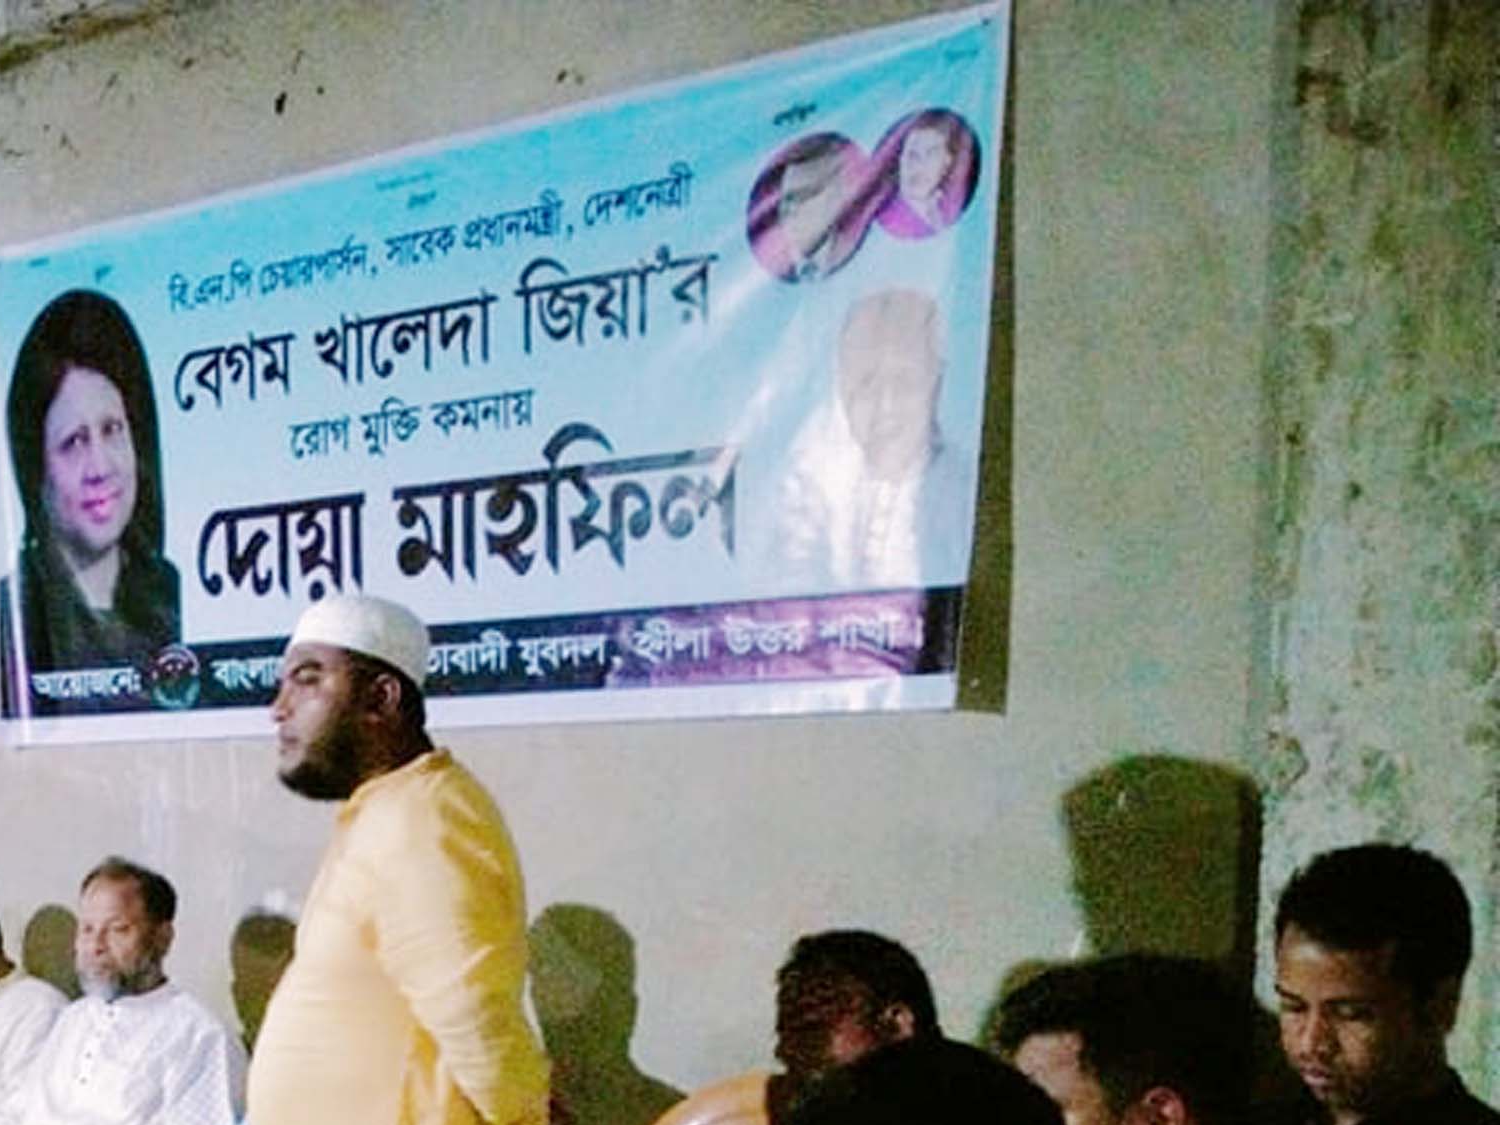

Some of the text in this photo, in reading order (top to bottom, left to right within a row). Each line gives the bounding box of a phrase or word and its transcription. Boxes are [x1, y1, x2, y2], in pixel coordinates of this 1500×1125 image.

[385, 225, 457, 263] সাবেক
[174, 332, 296, 411] বেগম
[314, 290, 499, 383] খালেদা
[289, 388, 537, 460] রোগ মুক্তি কমনায়
[198, 421, 740, 602] দোয়া মাহফিল
